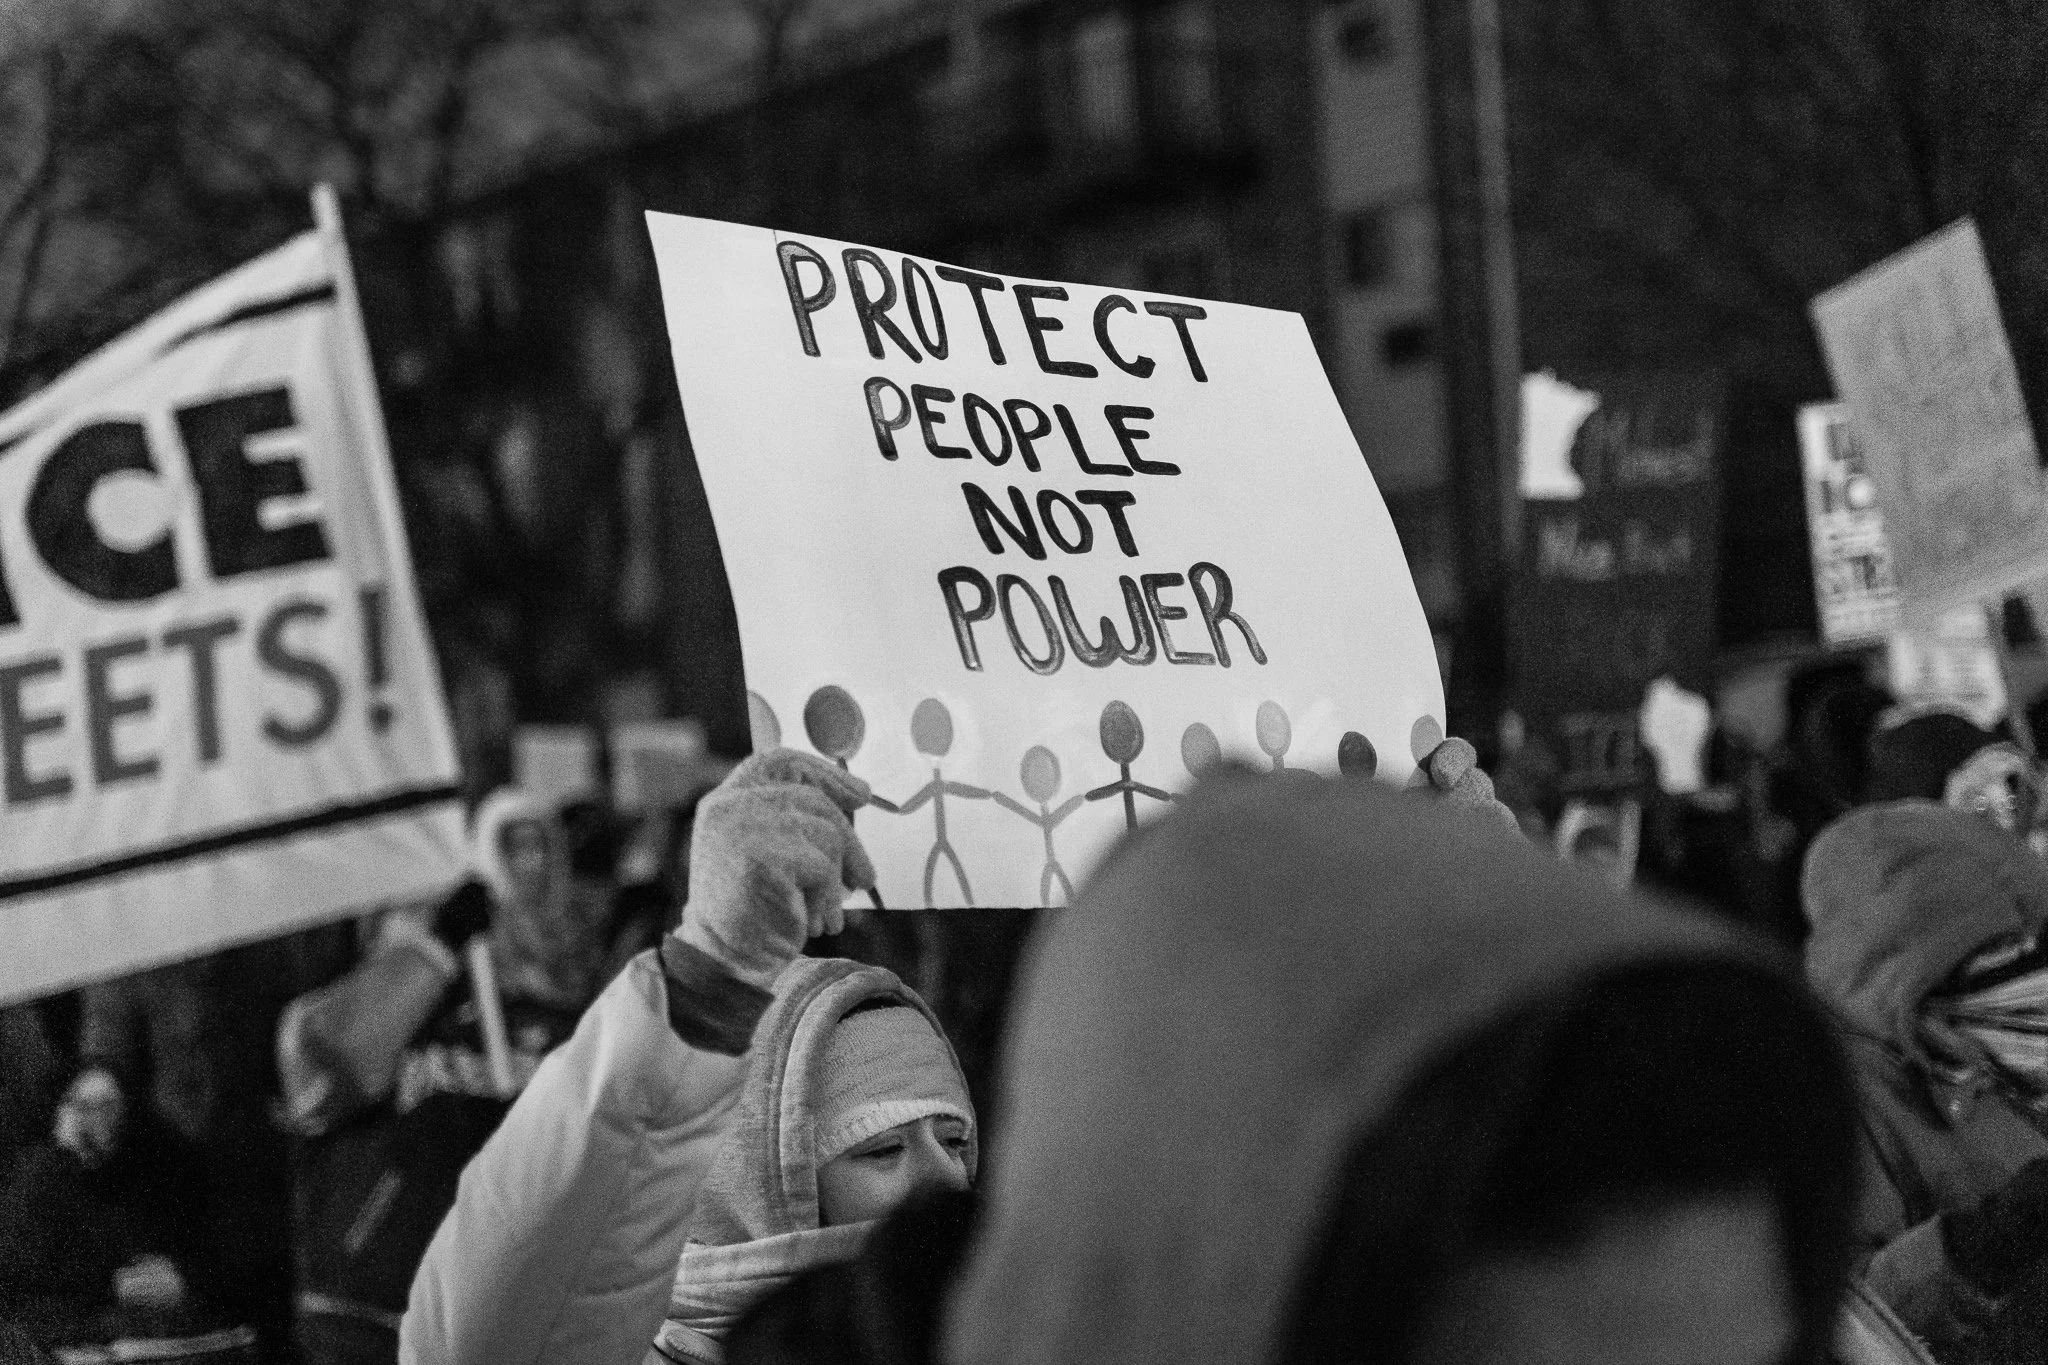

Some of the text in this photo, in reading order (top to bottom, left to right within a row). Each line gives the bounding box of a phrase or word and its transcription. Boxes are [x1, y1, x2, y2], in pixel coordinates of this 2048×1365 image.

[776, 241, 1208, 382] PROTECT
[863, 377, 1182, 476] PEOPLE
[0, 385, 334, 626] CE
[961, 482, 1139, 561] NOT
[937, 562, 1268, 676] POWER
